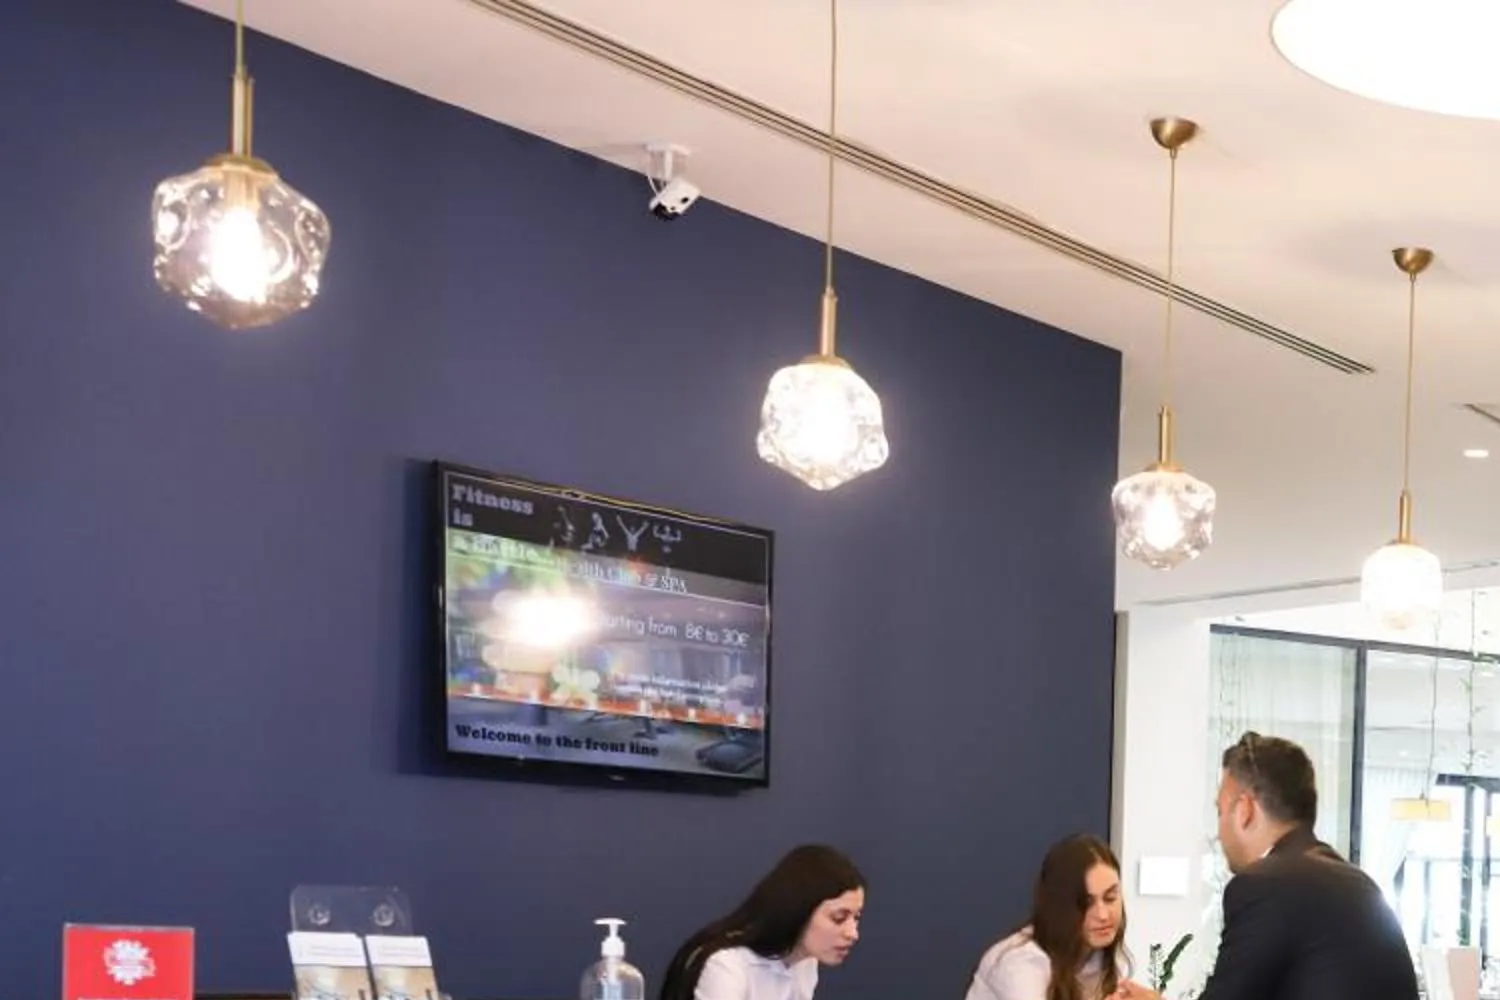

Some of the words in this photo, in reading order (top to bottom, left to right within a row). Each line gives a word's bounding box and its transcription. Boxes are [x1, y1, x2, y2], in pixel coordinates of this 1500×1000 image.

[451, 483, 535, 515] Fitness
[453, 507, 474, 527] is
[648, 616, 678, 637] from
[706, 628, 719, 643] to
[455, 724, 532, 746] Welcome
[535, 733, 553, 746] to
[556, 735, 582, 749] the
[585, 736, 626, 753] front
[629, 741, 660, 757] line
